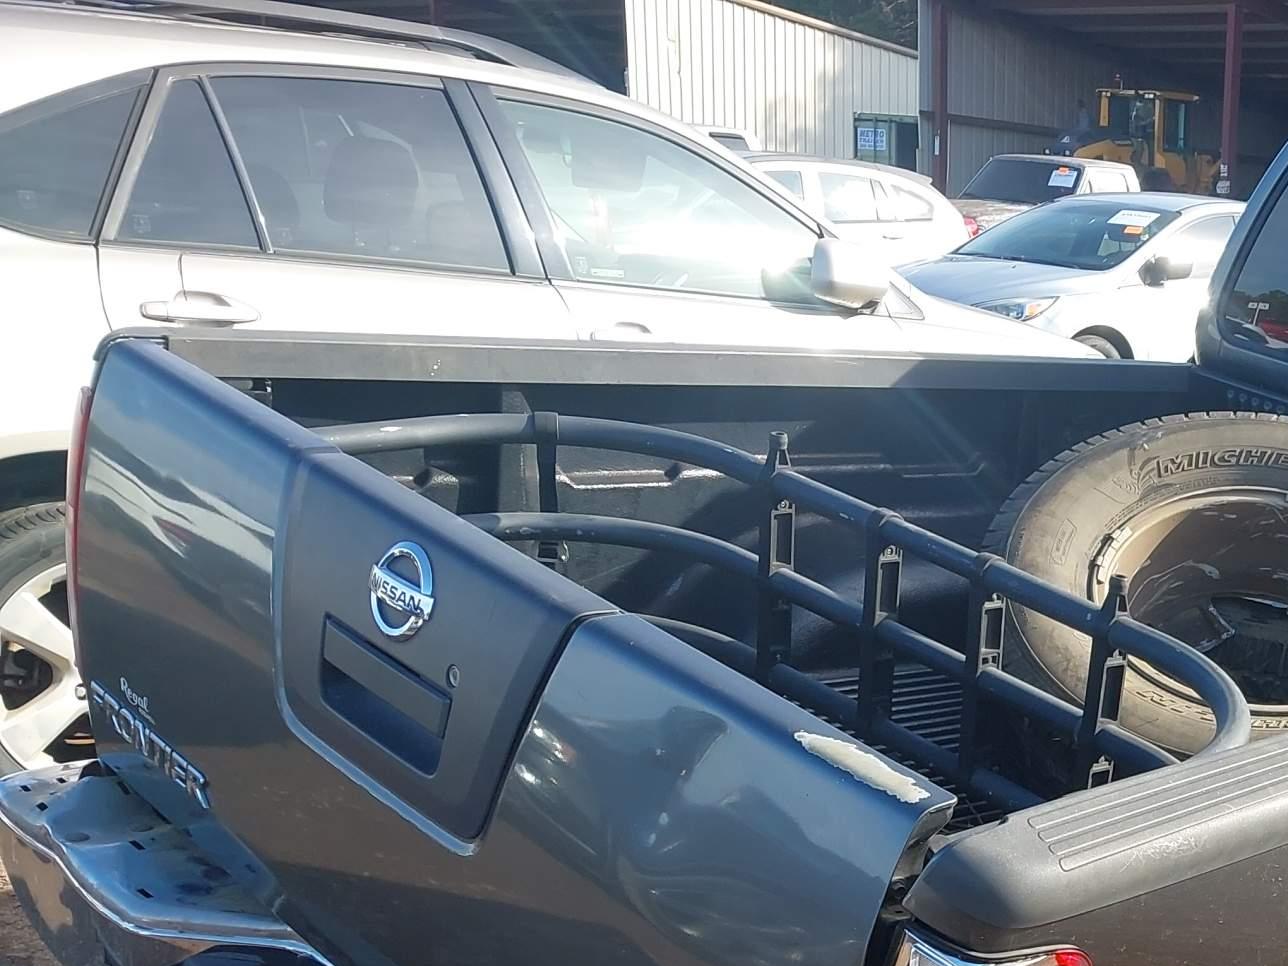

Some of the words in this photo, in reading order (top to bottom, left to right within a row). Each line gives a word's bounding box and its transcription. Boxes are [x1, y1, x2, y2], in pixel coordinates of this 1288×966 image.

[371, 570, 422, 613] NISSAN
[119, 676, 149, 713] Regal
[90, 680, 210, 810] FRONTIER
